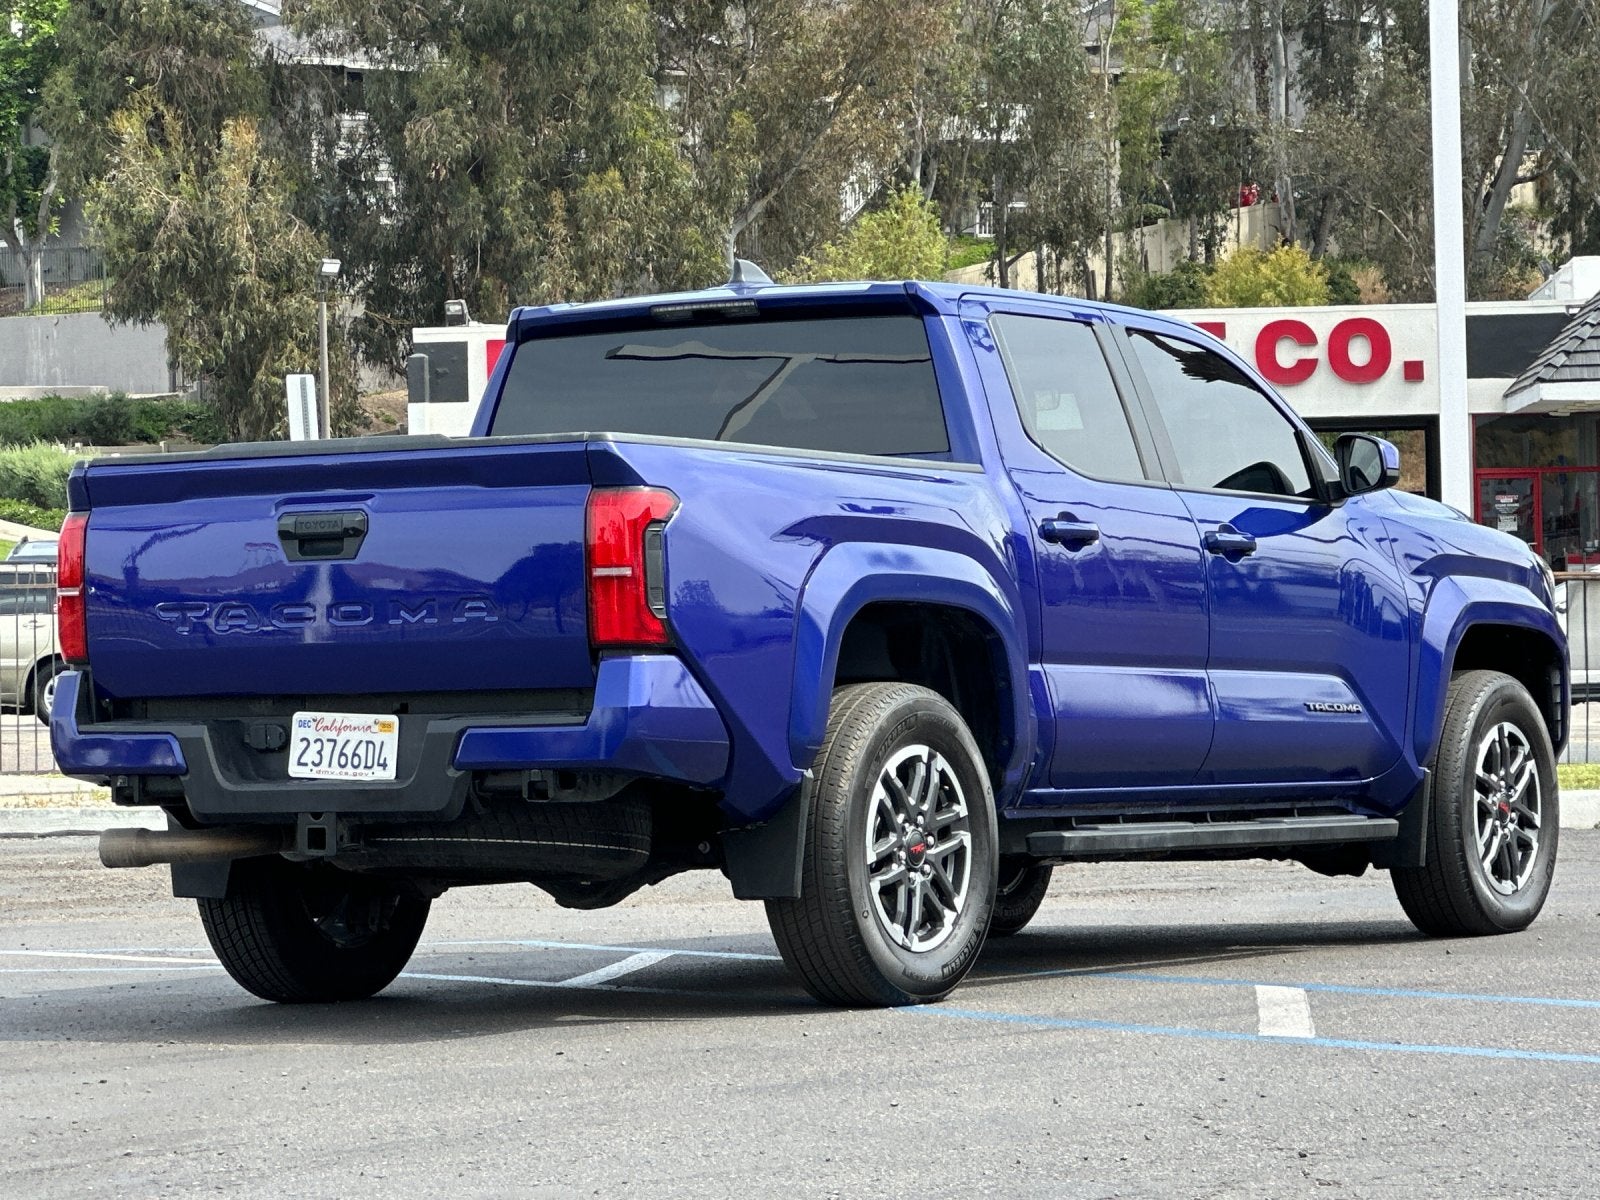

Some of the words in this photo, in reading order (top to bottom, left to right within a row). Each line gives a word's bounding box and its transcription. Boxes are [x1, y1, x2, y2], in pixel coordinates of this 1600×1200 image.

[1255, 317, 1424, 386] CO.
[298, 520, 339, 530] TOYOTA
[154, 599, 499, 635] TACOMA
[1303, 702, 1362, 713] TACOMA
[298, 719, 312, 728] DEC
[315, 717, 378, 736] California
[296, 737, 388, 770] 23766D4
[315, 768, 369, 777] dmv.ca.gov
